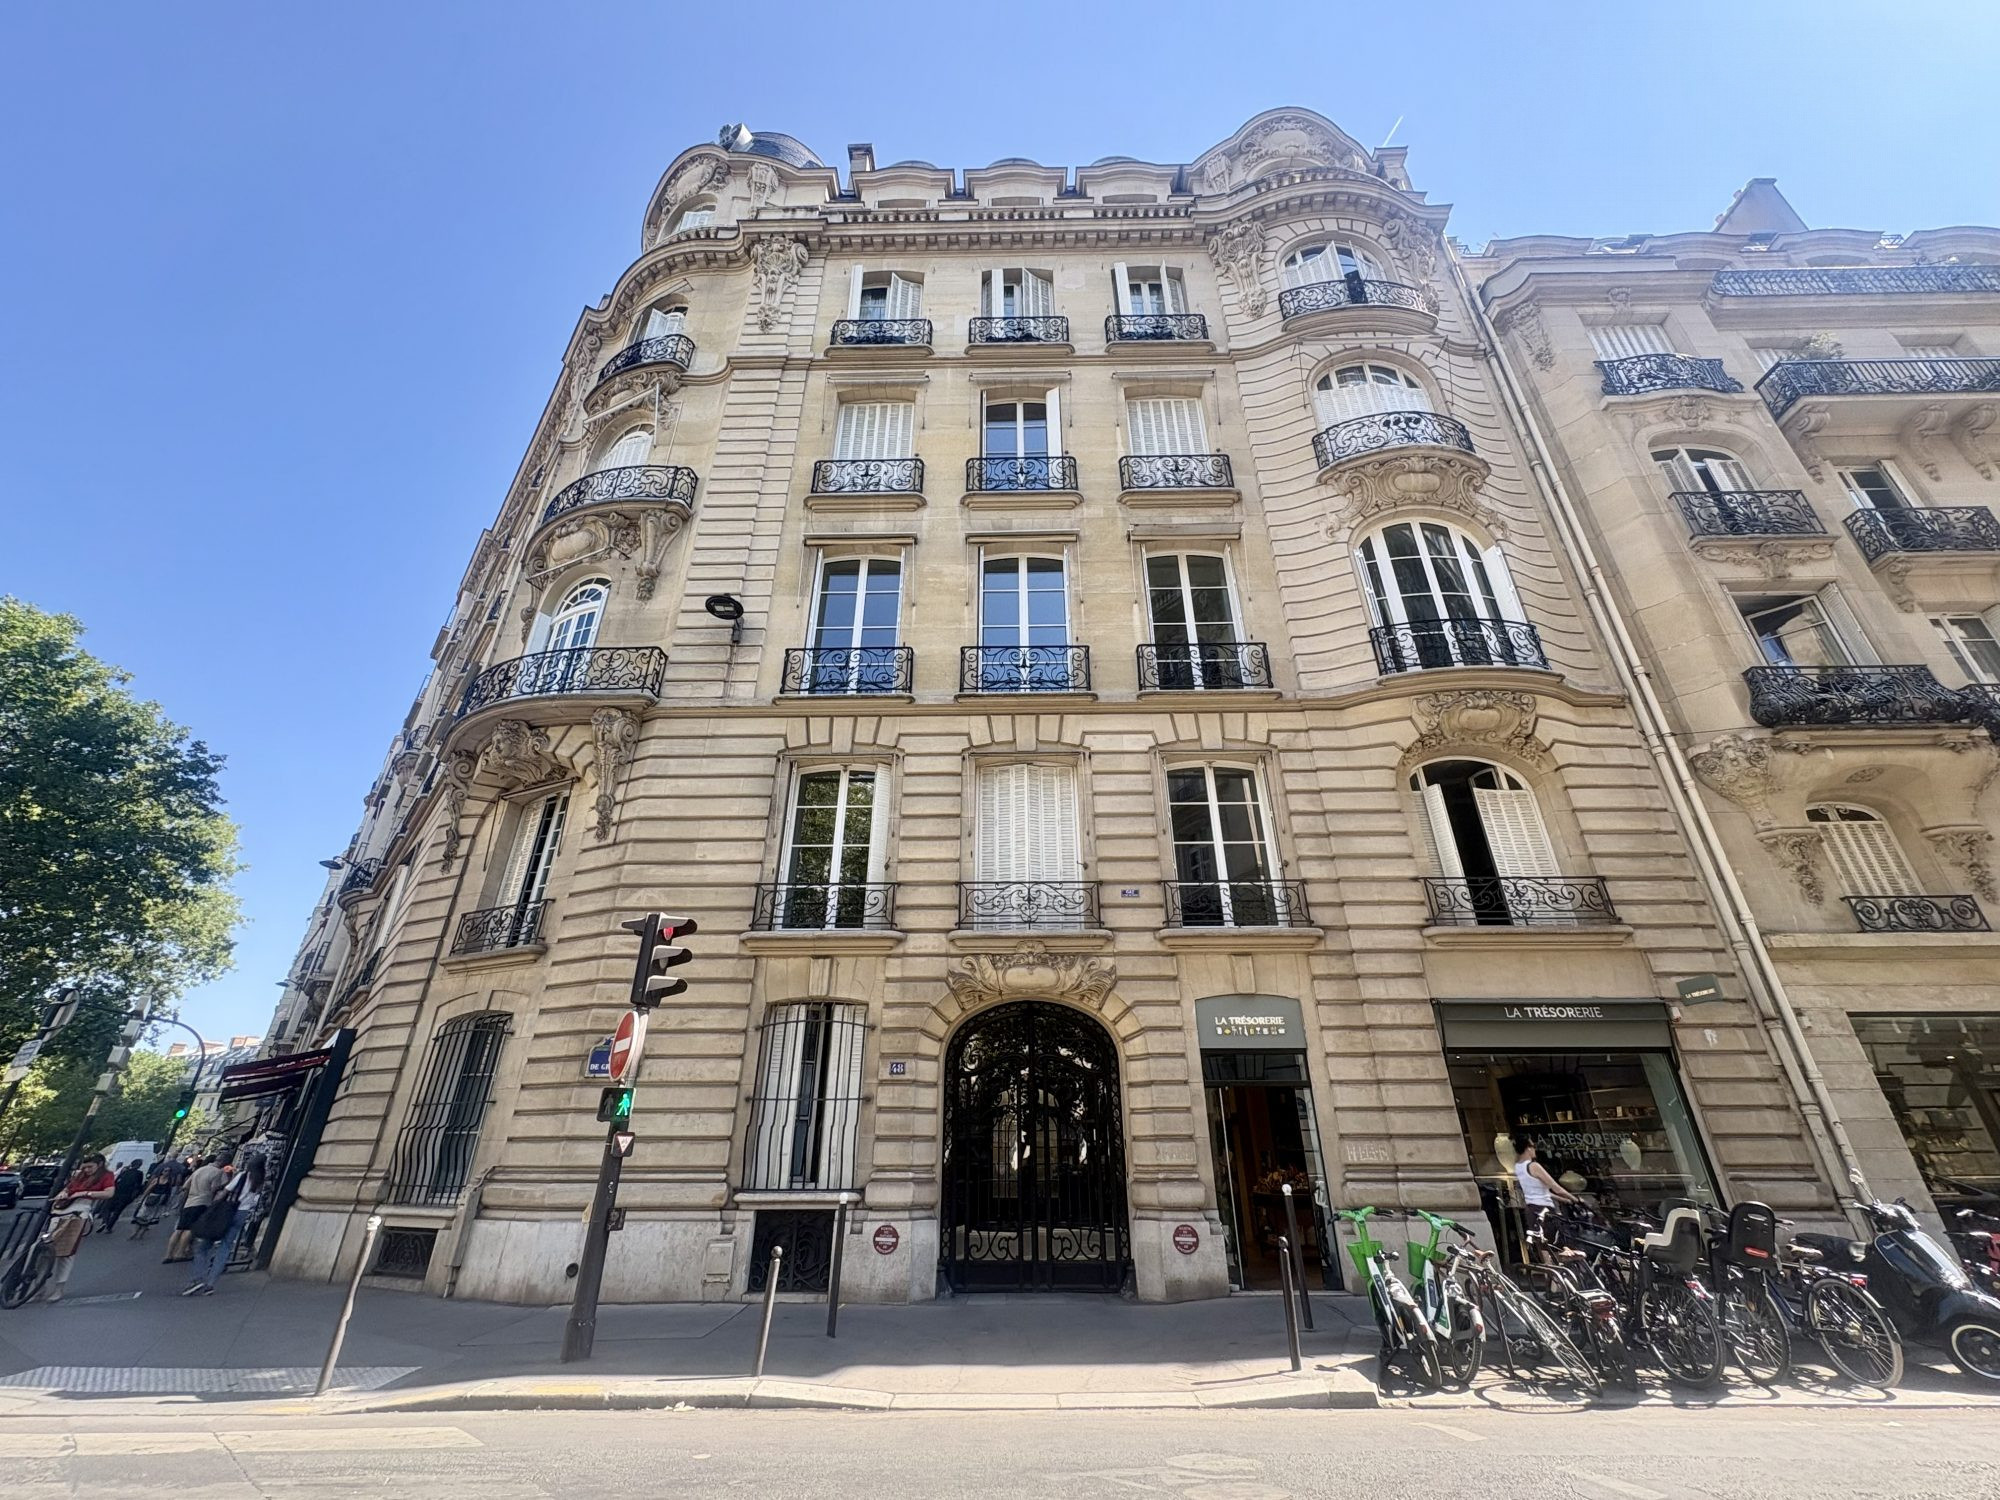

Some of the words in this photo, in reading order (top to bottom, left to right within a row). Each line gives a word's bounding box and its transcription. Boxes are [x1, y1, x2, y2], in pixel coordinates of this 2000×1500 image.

[1504, 1007, 1522, 1018] LA
[1523, 1005, 1603, 1018] TRÉSORERIE
[1215, 1016, 1227, 1025] LA
[1228, 1014, 1285, 1025] TRÉSORERIE
[590, 1063, 600, 1071] DE
[892, 1063, 904, 1073] 48
